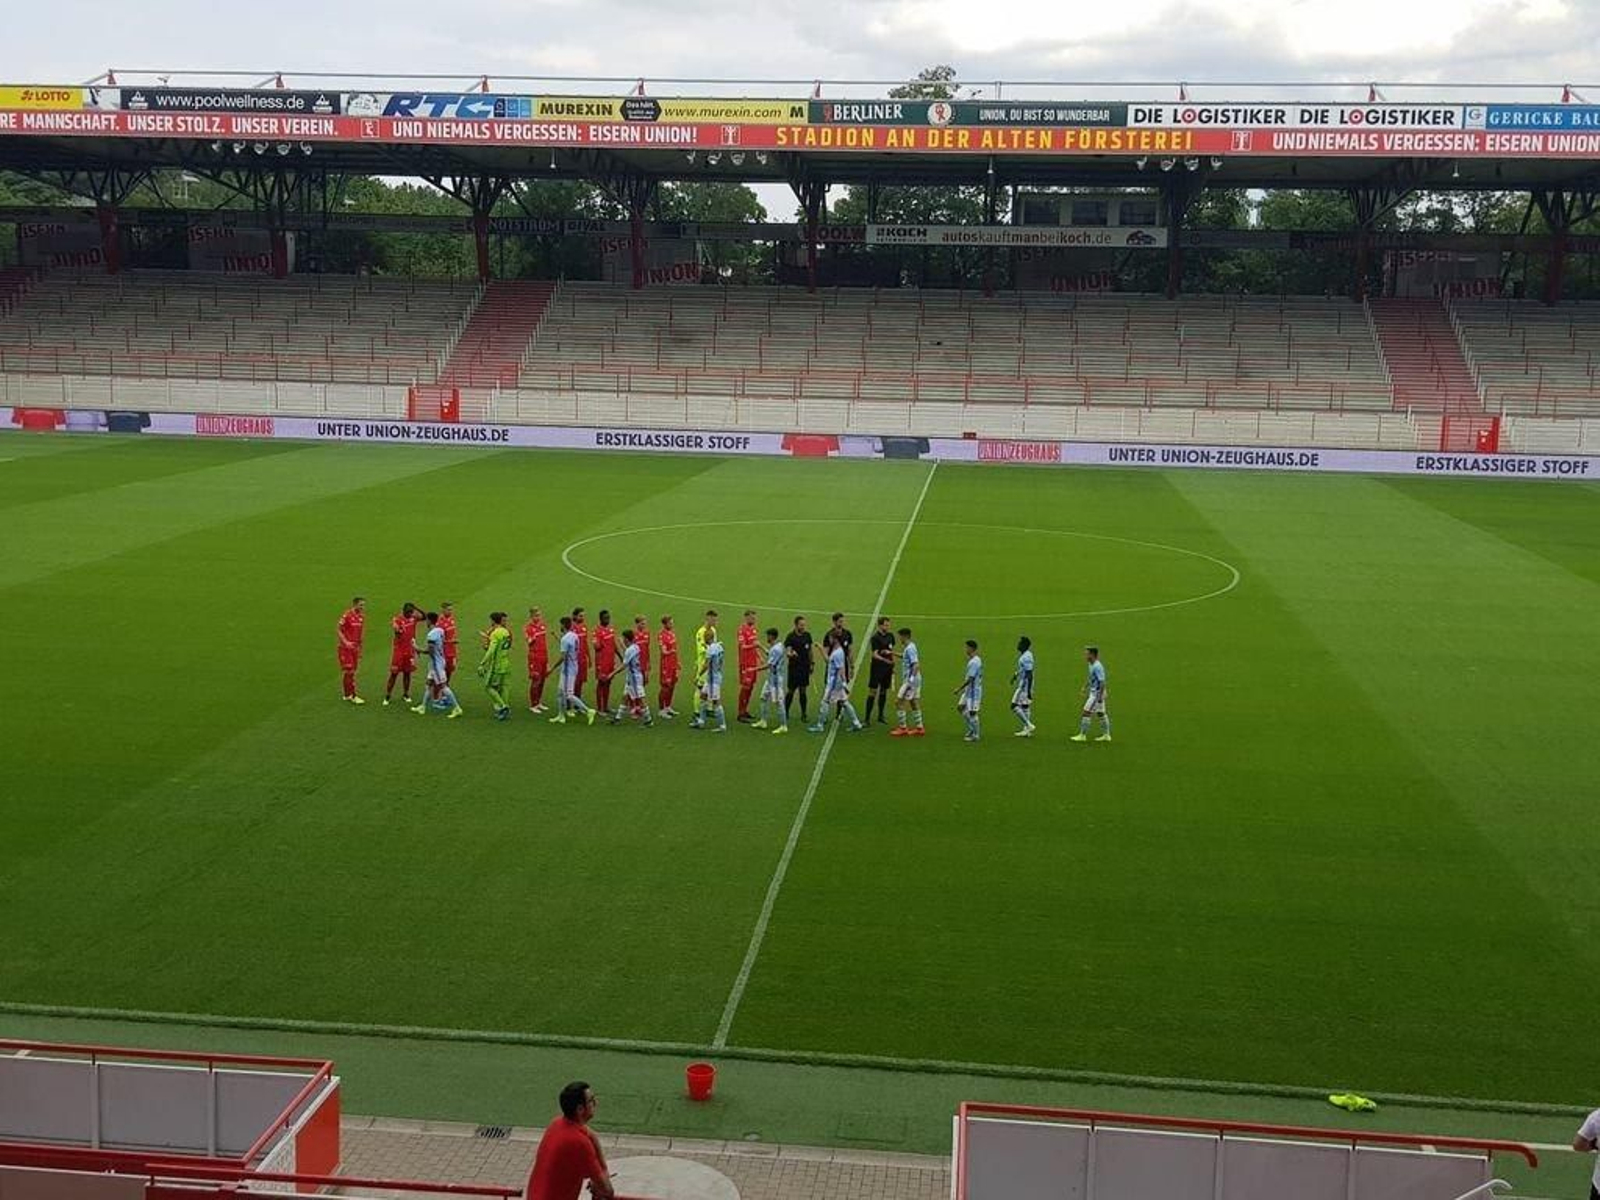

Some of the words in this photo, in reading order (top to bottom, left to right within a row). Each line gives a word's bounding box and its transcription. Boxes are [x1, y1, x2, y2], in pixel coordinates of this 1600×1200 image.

[35, 90, 71, 101] LOTTO
[156, 94, 304, 110] www.poolwellness.de
[540, 102, 613, 116] MUREXIN
[664, 105, 781, 119] www.murexin.com
[833, 103, 904, 122] BERLINER
[1010, 109, 1022, 120] DU
[1023, 109, 1042, 121] BIST
[1043, 109, 1055, 121] SO
[1056, 110, 1110, 122] WUNDERBAR
[1134, 109, 1163, 123] DIE
[1173, 108, 1286, 124] LOGISTIKER
[1300, 109, 1329, 124] DIE
[1339, 109, 1454, 125] LOGISTIKER
[22, 113, 120, 131] MANNSCHAFT.
[127, 114, 174, 133] UNSER
[177, 115, 226, 133] STOLZ.
[232, 117, 278, 134] UNSER
[283, 118, 338, 136] VEREIN.
[1489, 111, 1563, 125] GERICKE
[393, 121, 422, 138] UND
[427, 122, 490, 139] NIEMALS
[494, 124, 582, 141] VERGESSEN:
[589, 126, 640, 143] EISERN
[645, 127, 697, 143] UNION!
[776, 127, 875, 146] STADION
[886, 128, 915, 148] AN
[928, 129, 969, 148] DER
[981, 130, 1052, 149] ALTEN
[1064, 128, 1192, 150] FÖRSTEREI
[1383, 133, 1480, 152] VERGESSEN:
[1485, 134, 1543, 152] EISERN
[1548, 134, 1600, 153] UNION
[886, 227, 928, 238] KOCH
[941, 230, 1112, 244] autoskauftmanbeikoch.de
[318, 422, 361, 437] UNTER
[366, 424, 509, 442] UNION-ZEUGHAUS.DE
[596, 432, 704, 449] ERSTKLASSIGER
[708, 436, 750, 450] STOFF
[1109, 447, 1156, 463] UNTER
[1161, 450, 1319, 467] UNION-ZEUGHAUS.DE
[1416, 456, 1537, 474] ERSTKLASSIGER
[1541, 460, 1590, 475] STOFF
